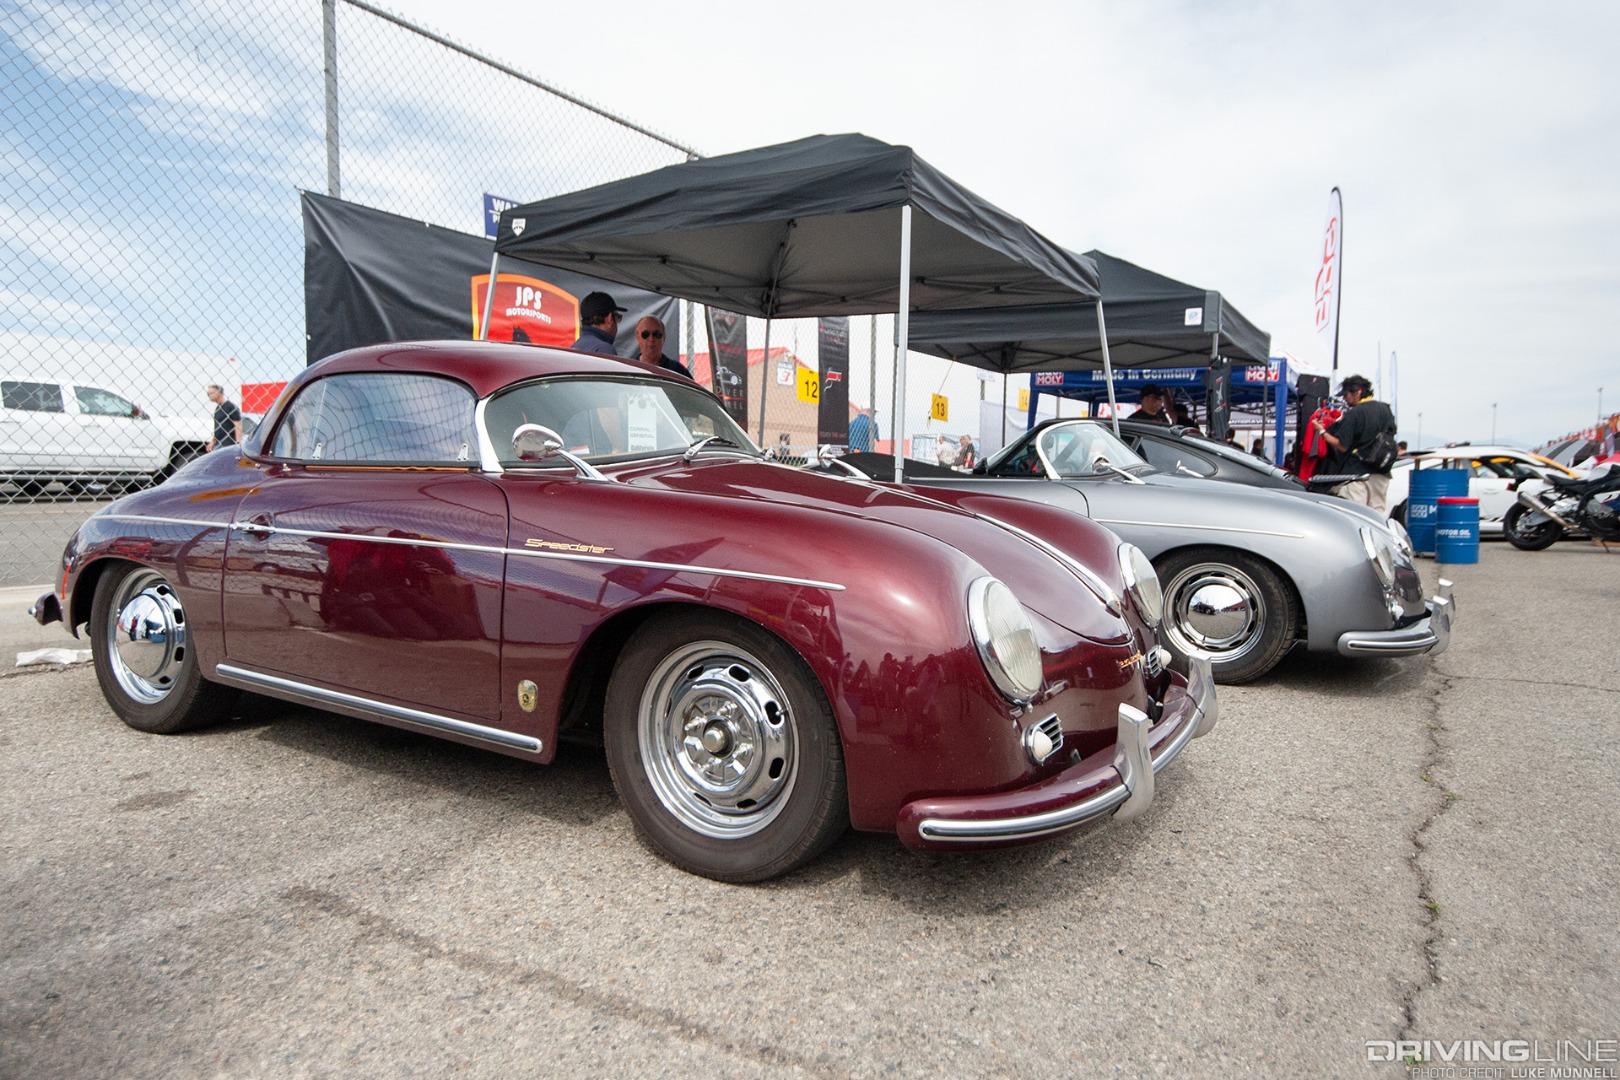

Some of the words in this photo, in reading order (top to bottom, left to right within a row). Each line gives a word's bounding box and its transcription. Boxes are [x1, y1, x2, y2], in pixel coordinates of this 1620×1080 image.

[515, 286, 542, 310] JPS
[506, 307, 552, 325] MOTORSPORTS
[1037, 375, 1062, 385] MOLY
[1142, 369, 1197, 381] Germany
[804, 380, 818, 399] 12
[936, 402, 946, 417] 13
[525, 538, 615, 554] Speedster
